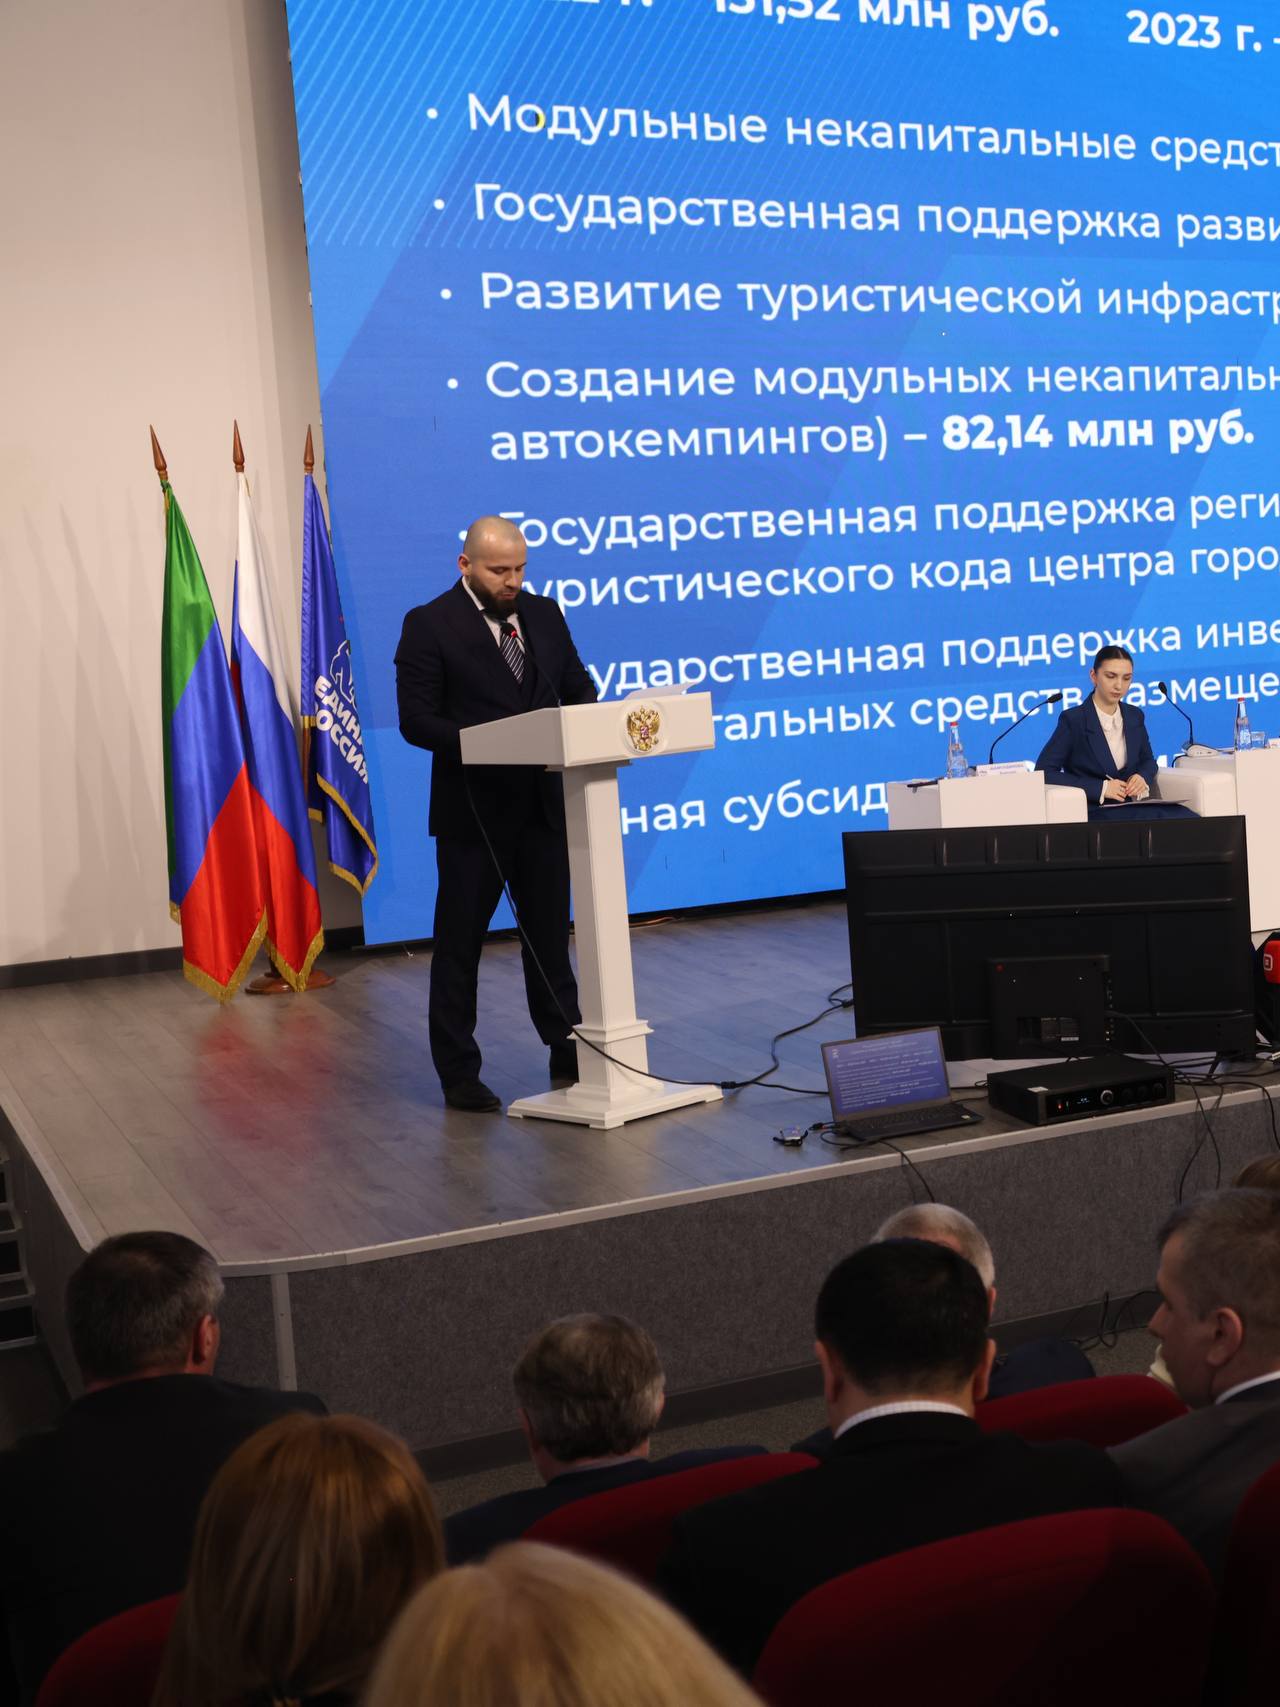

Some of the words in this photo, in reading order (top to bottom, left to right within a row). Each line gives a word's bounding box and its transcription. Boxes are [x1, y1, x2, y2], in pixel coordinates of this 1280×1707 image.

[858, 0, 951, 29] млн
[967, 0, 1060, 43] руб.
[1126, 9, 1221, 49] 2023
[1236, 24, 1262, 52] г.
[468, 92, 768, 146] Модульные
[786, 117, 1137, 160] некапитальные
[474, 183, 900, 235] Государственная
[918, 205, 1161, 245] поддержка
[481, 271, 722, 311] Развитие
[736, 277, 1082, 321] туристической
[485, 360, 736, 403] Создание
[754, 366, 1012, 404] модульных
[490, 415, 888, 462] автокемпингов)
[942, 414, 1054, 456] 82,14
[1067, 419, 1154, 448] млн
[1168, 407, 1255, 454] руб.
[934, 496, 1176, 534] поддержка
[910, 558, 1012, 592] кода
[1029, 550, 1175, 587] центра
[942, 625, 1182, 668] поддержка
[314, 674, 362, 746] ЕДИН
[910, 685, 1084, 733] средств
